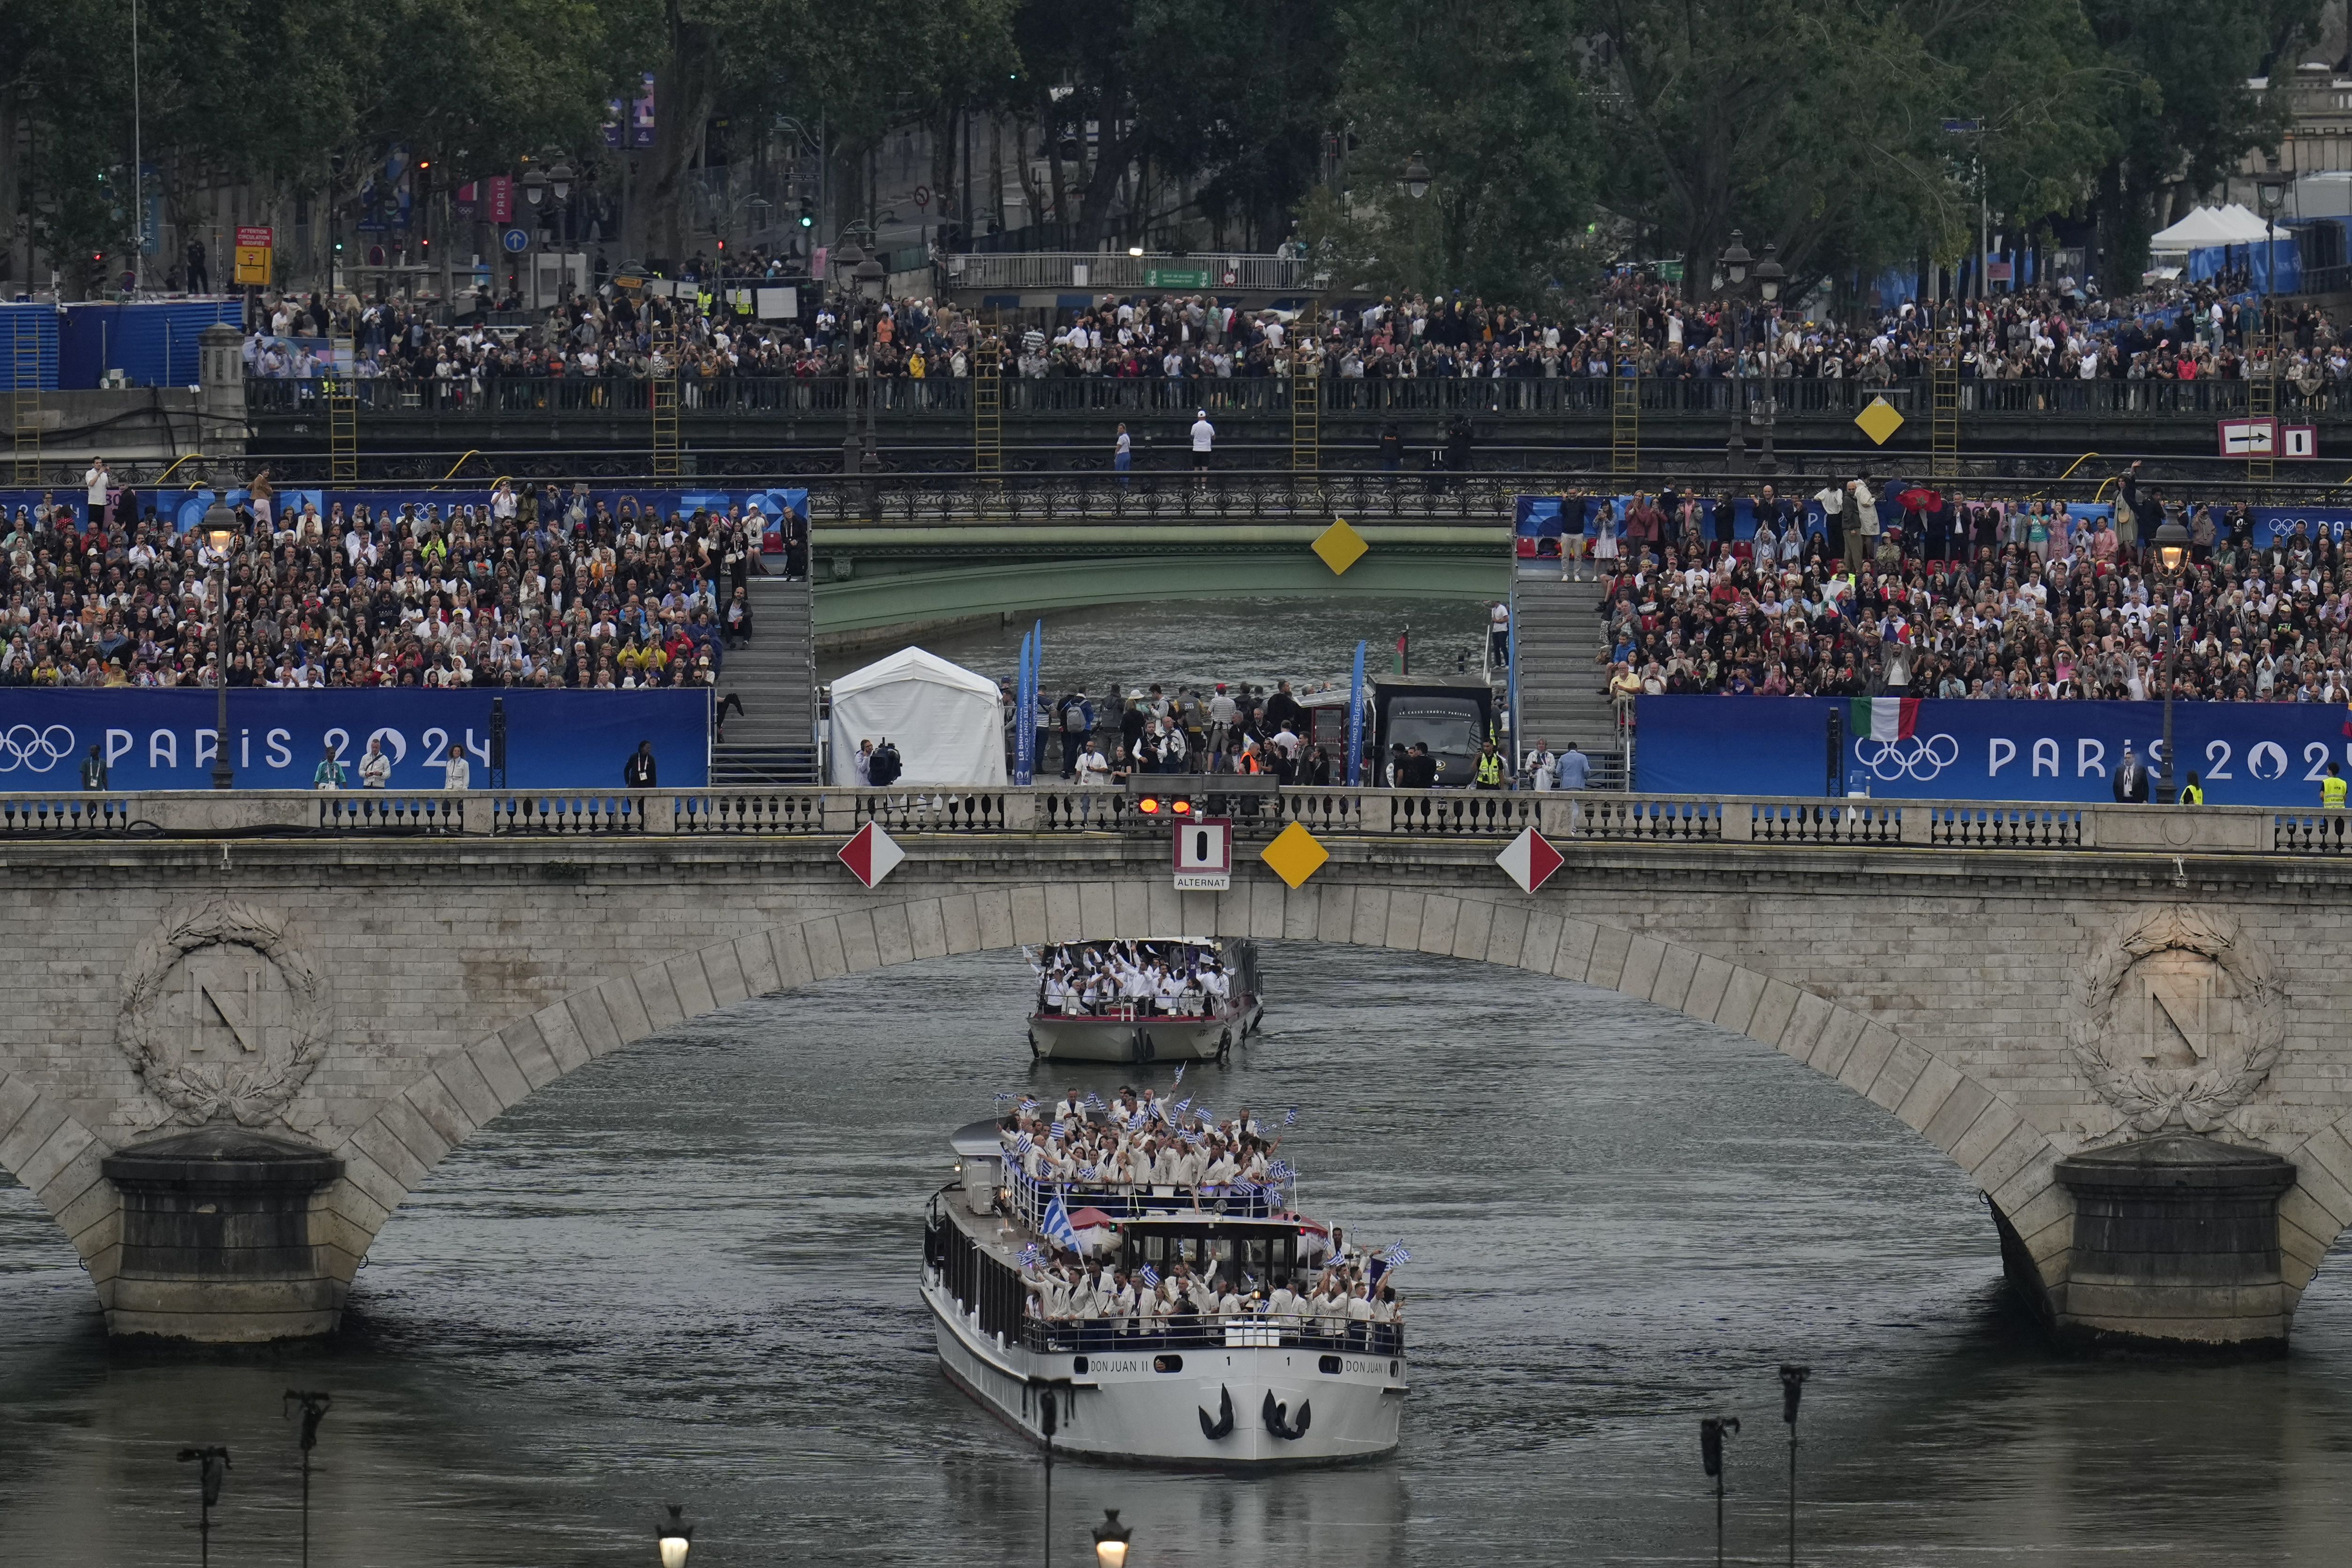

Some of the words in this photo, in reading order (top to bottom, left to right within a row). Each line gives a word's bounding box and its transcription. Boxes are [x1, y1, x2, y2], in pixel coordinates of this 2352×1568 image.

[497, 181, 506, 215] PARIS
[1178, 879, 1226, 887] ALTERNAT
[189, 966, 260, 1052] N
[2140, 974, 2212, 1059] N
[1091, 1361, 1108, 1372] DON
[1111, 1361, 1137, 1372] JUAN
[1142, 1361, 1148, 1372] II
[1226, 1356, 1230, 1366] 1
[1286, 1356, 1290, 1366] 1
[1346, 1361, 1365, 1373] DON
[1367, 1362, 1383, 1374] JUAN
[1384, 1363, 1388, 1374] II
